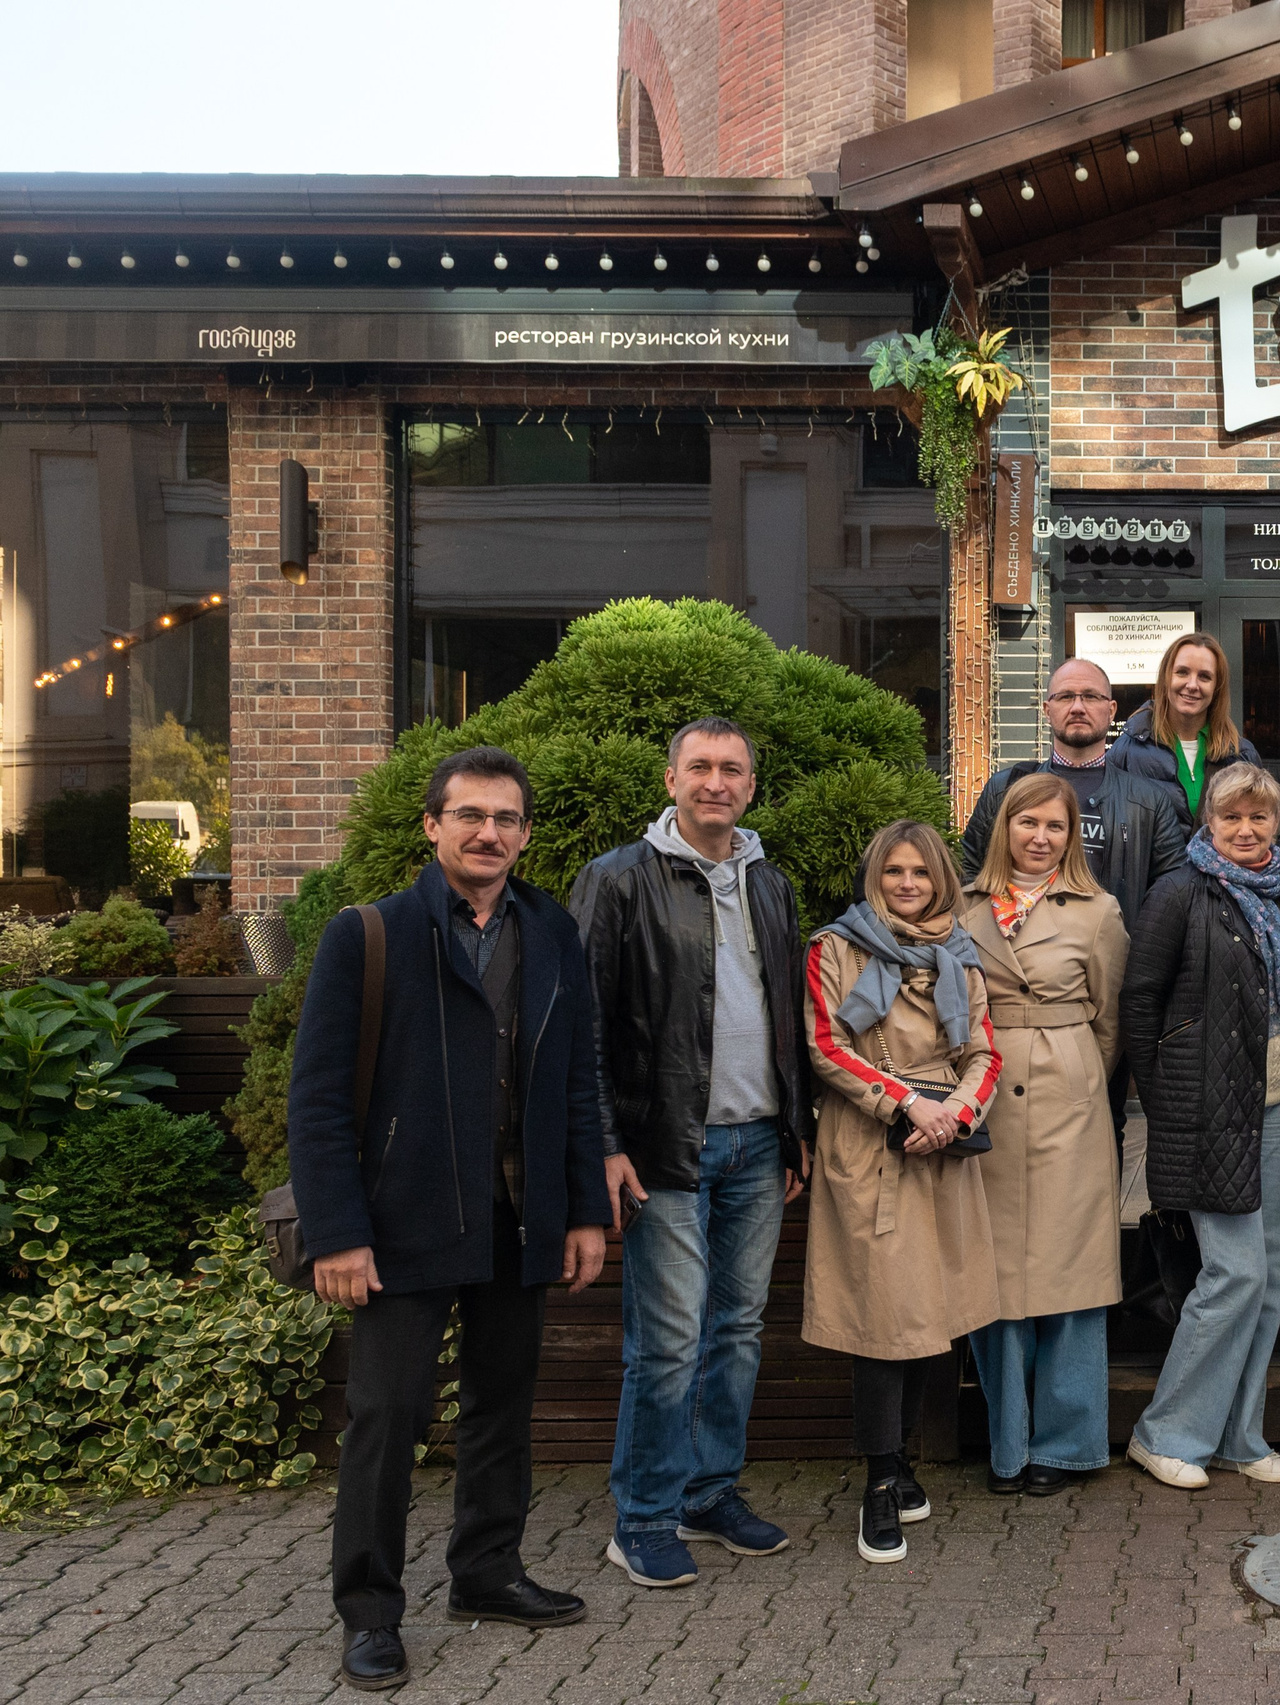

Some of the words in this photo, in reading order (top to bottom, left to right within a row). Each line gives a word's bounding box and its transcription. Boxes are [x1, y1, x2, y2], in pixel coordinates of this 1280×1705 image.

[494, 330, 594, 348] ресторан
[600, 328, 722, 349] грузинской
[728, 332, 789, 350] кухни
[1009, 461, 1022, 528] ХИНКАЛИ
[1007, 533, 1020, 598] СЪЕДЕНО
[1086, 623, 1136, 632] СОБЛЮДАЙТЕ
[1136, 624, 1184, 632] ДИСТАНЦИЮ
[1108, 614, 1161, 623] ПОЖАЛУЙСТА,
